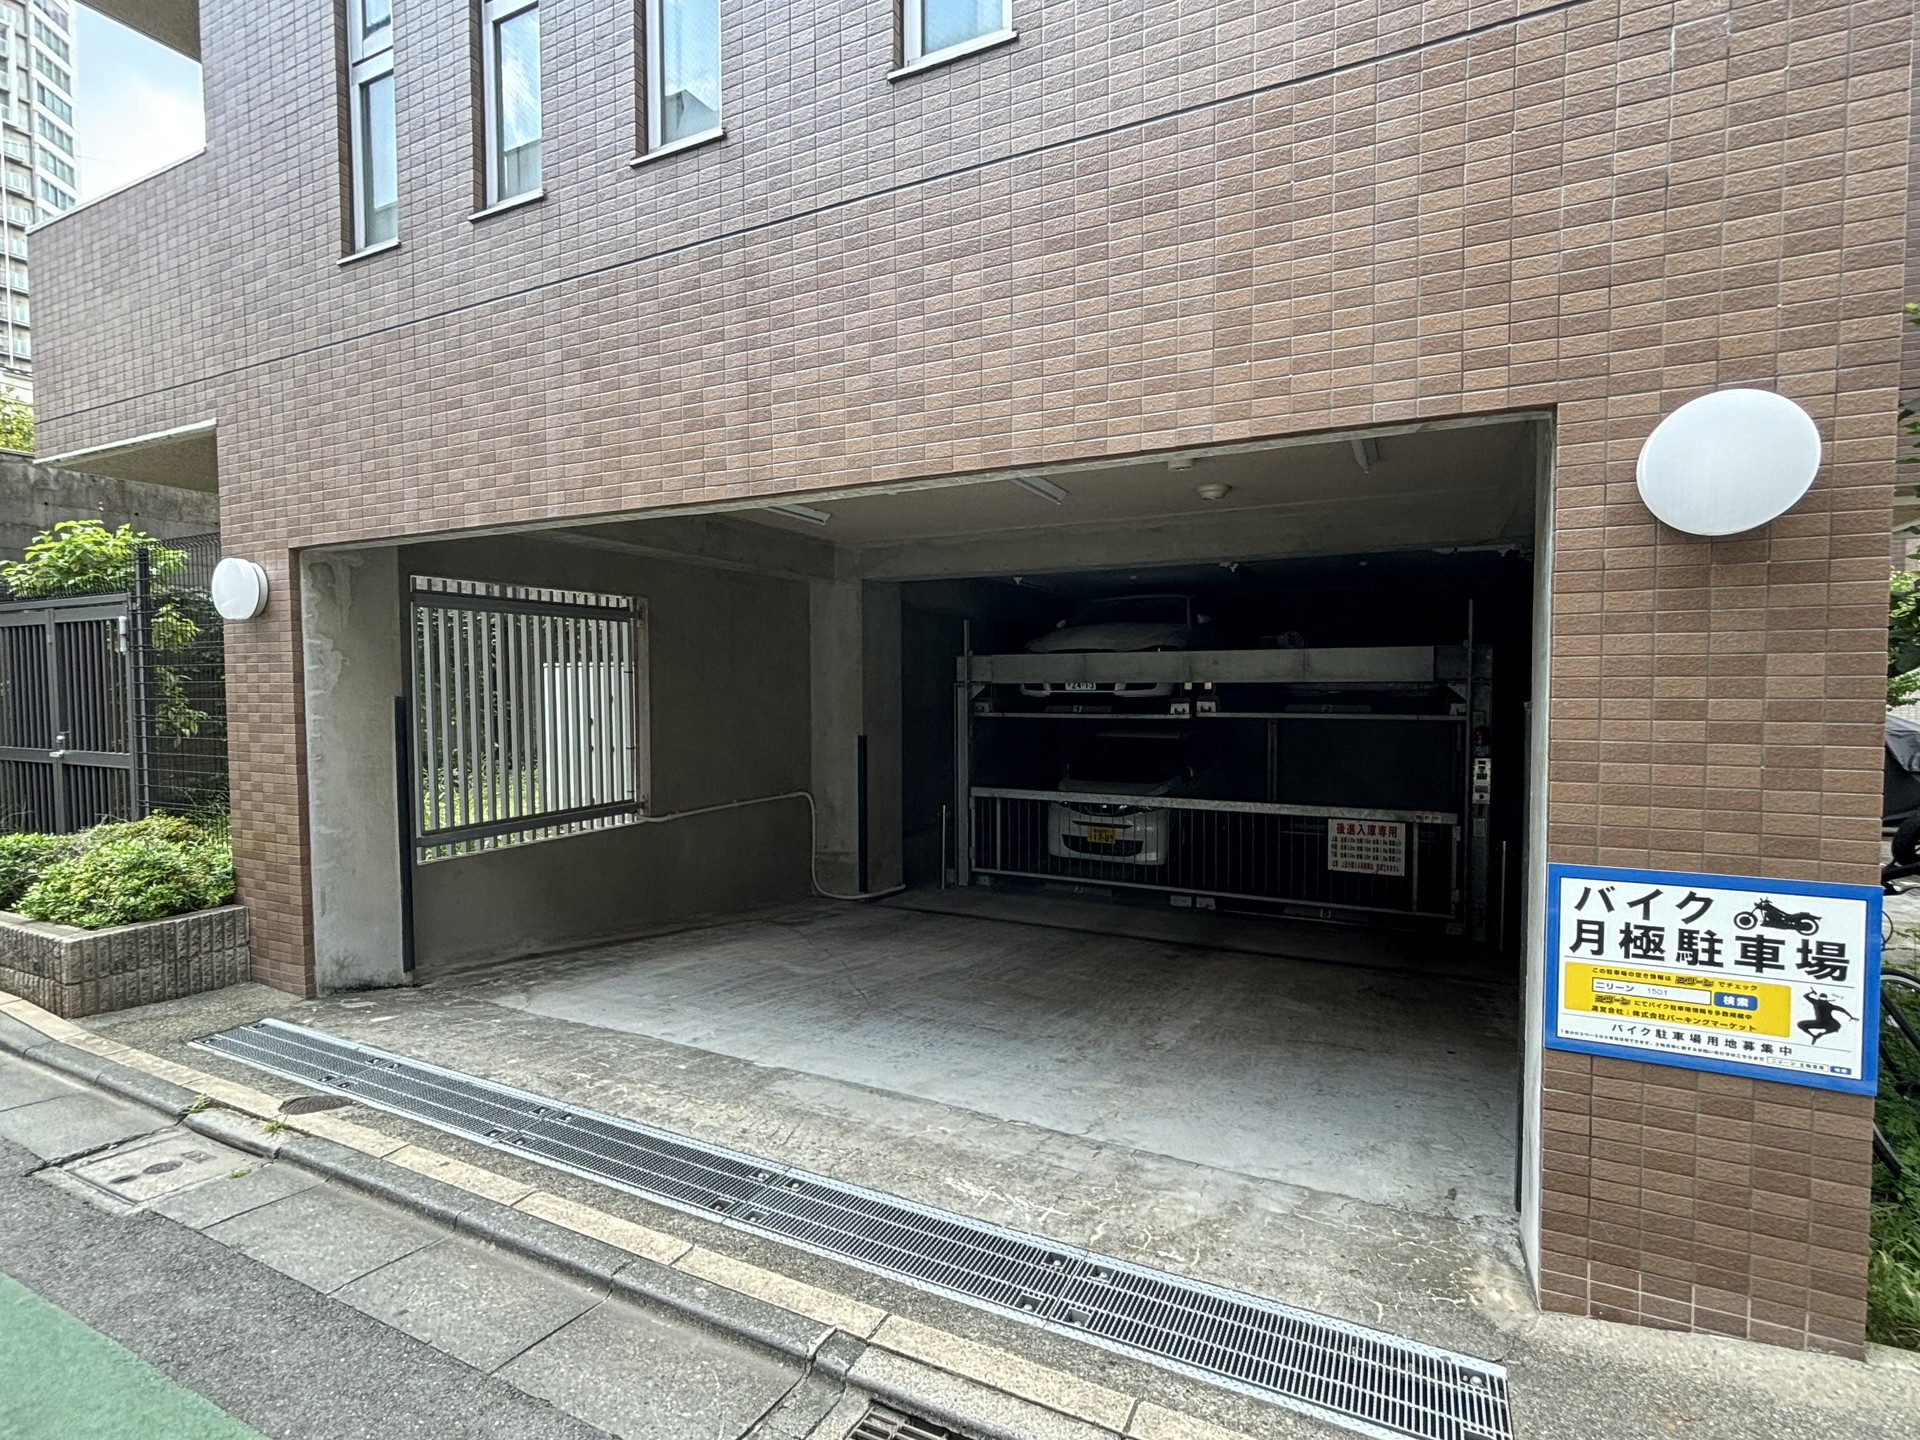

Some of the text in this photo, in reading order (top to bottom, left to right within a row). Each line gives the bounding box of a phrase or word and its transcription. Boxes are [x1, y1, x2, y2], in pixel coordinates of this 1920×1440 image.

[1336, 822, 1398, 838] 後進入庫専用
[1574, 886, 1714, 925] バイク
[1569, 919, 1850, 981] 月極駐車場
[1595, 981, 1749, 1008] ニリーン 1501 検索
[1611, 1023, 1793, 1057] バイク駐車場用地募集中
